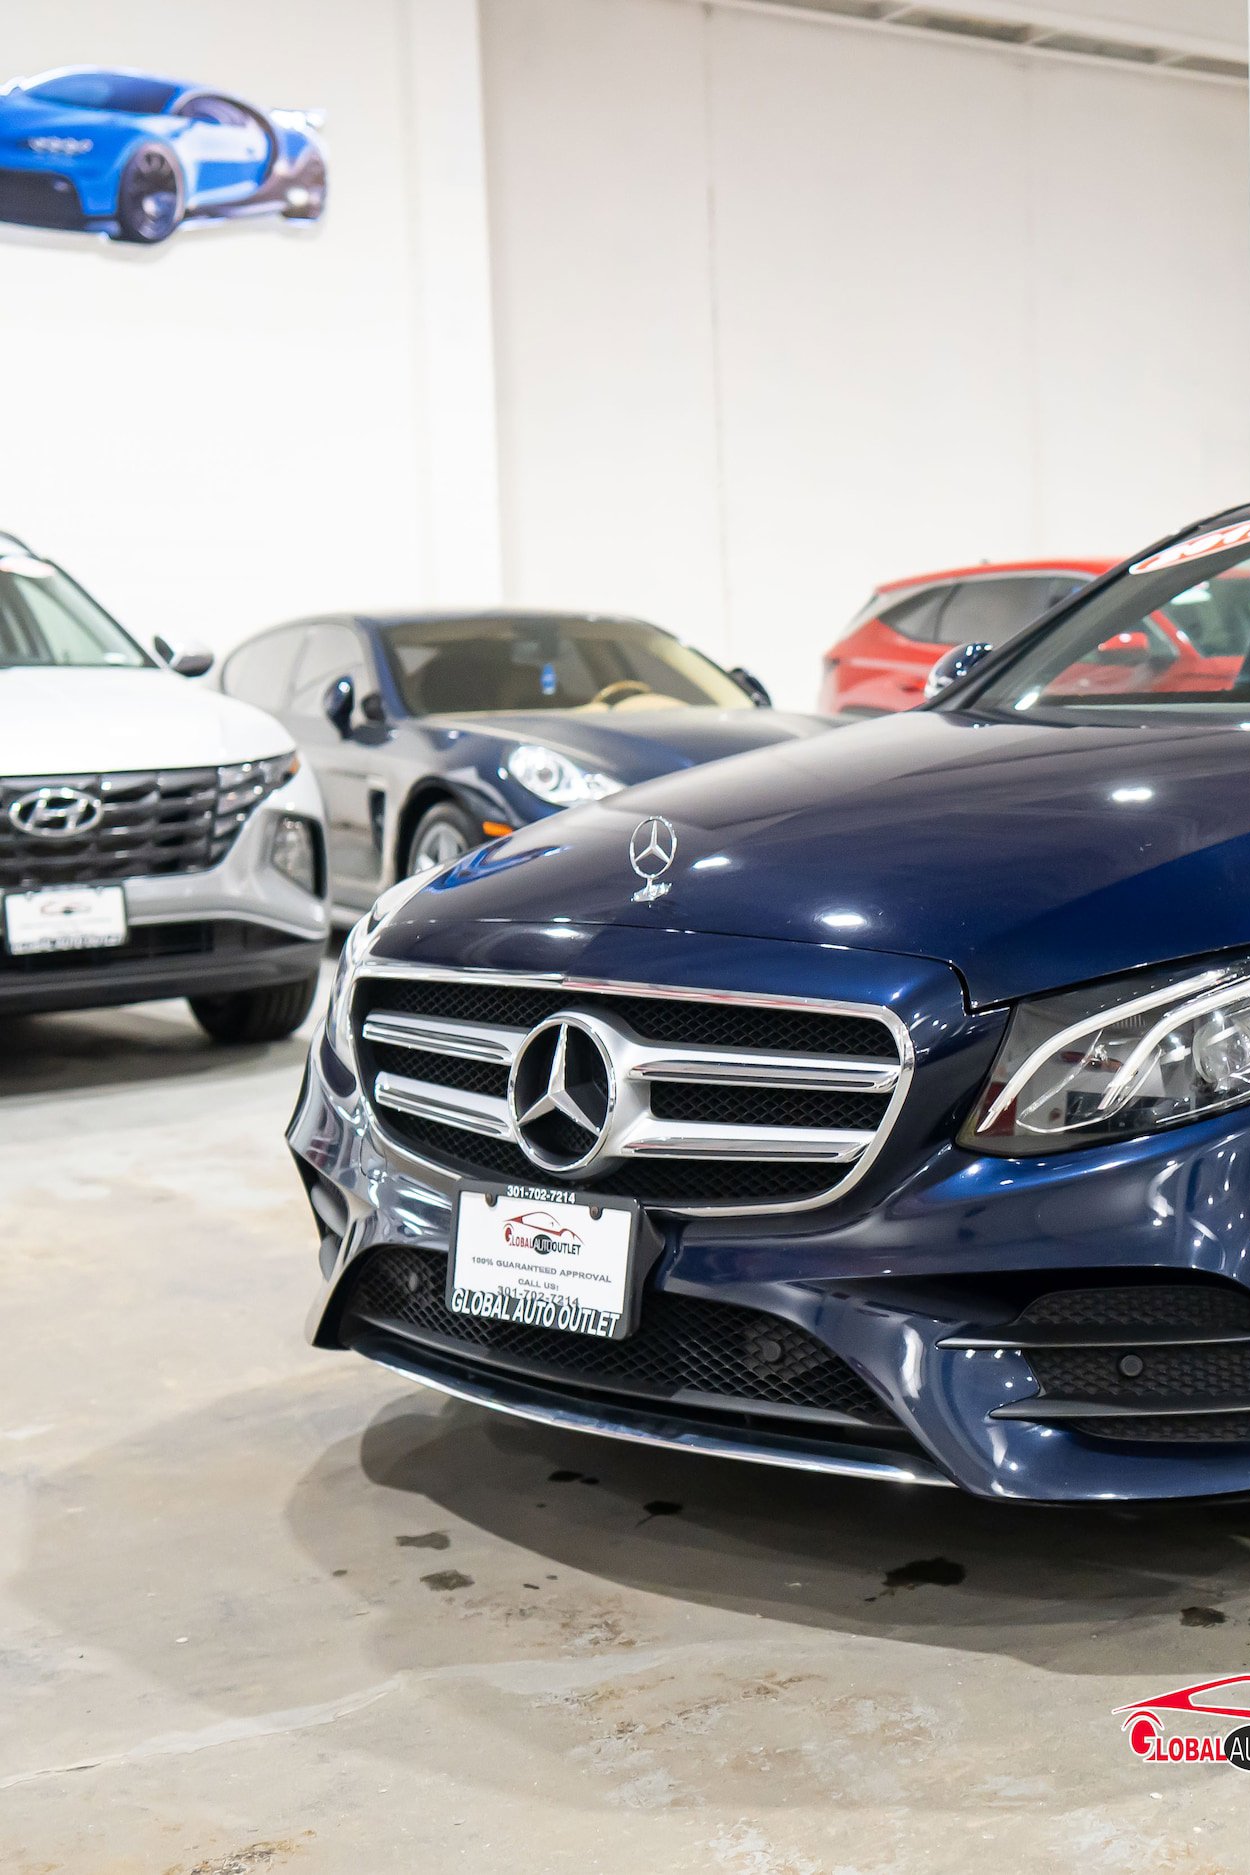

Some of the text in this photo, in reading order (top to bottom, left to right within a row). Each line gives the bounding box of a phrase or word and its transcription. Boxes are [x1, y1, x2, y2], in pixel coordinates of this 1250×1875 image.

[507, 1185, 576, 1204] 301-702-7214
[472, 1256, 612, 1283] 100% GUARANTEED APPROVAL
[518, 1278, 541, 1288] CALL
[451, 1288, 620, 1337] GLOBAL AUTO OUTLET
